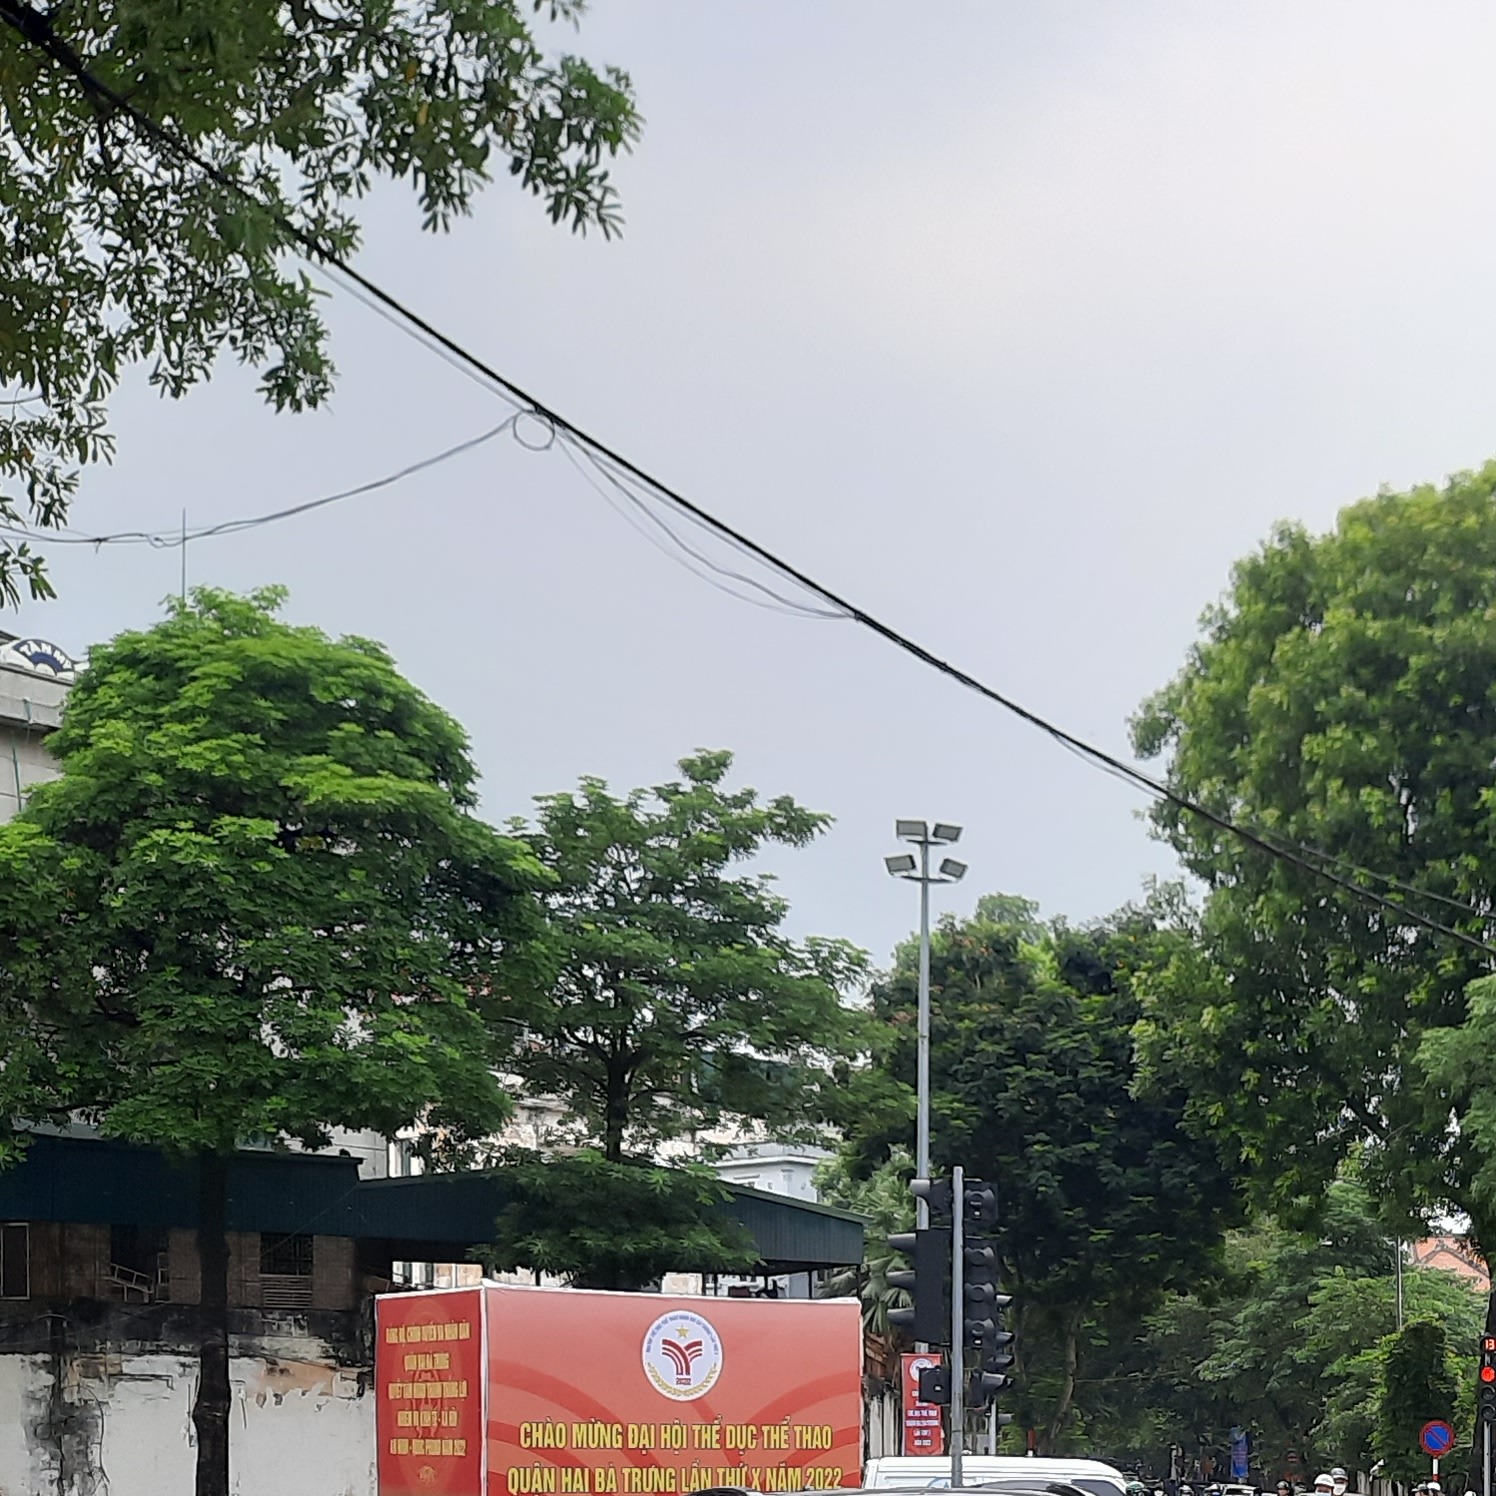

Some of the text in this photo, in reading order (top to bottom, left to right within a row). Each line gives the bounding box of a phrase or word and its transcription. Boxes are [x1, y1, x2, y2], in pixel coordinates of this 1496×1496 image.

[1485, 1339, 1495, 1350] 13
[519, 1414, 833, 1455] CHÀO MỪNG ĐẠI HỘI THỂ DỤC THỂ THAO
[560, 1467, 590, 1493] HAI
[594, 1461, 618, 1493] BÀ
[621, 1465, 677, 1493] TRƯNG
[751, 1467, 761, 1492] X
[765, 1461, 802, 1492] NĂM
[805, 1467, 843, 1489] 2022
